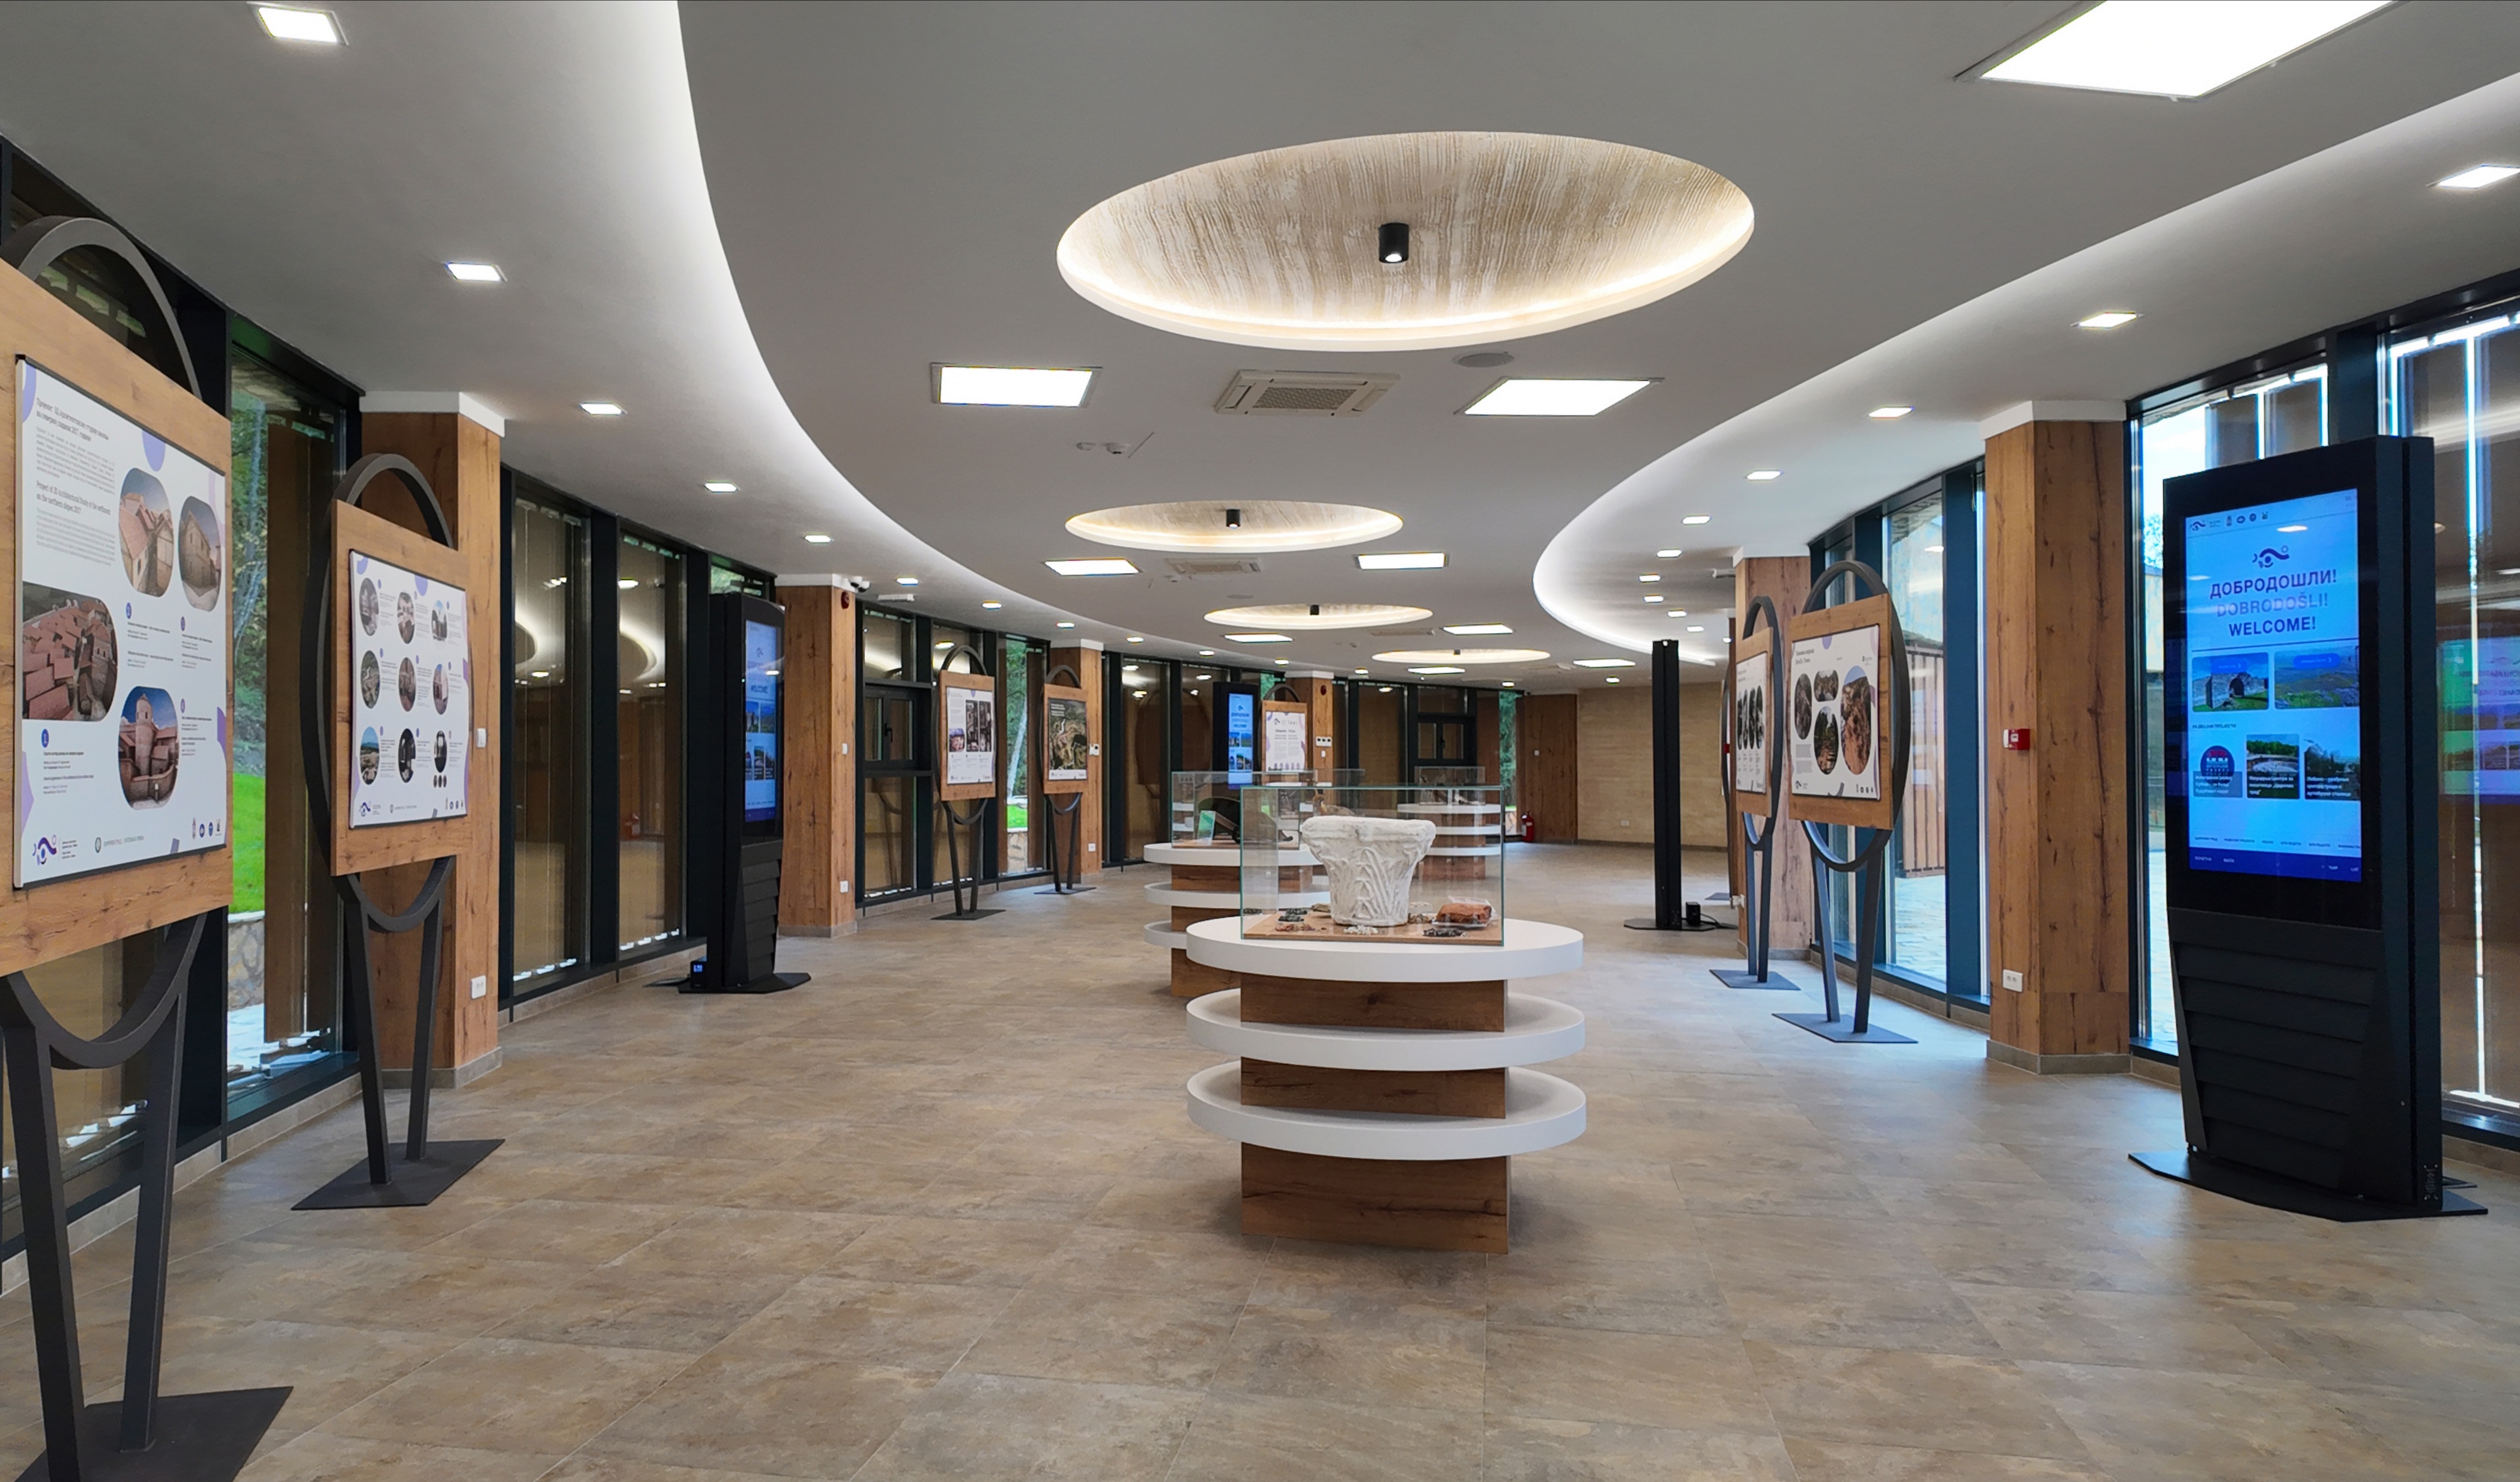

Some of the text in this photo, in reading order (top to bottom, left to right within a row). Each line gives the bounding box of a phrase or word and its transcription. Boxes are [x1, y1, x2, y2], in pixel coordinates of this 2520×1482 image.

[2210, 569, 2337, 599] ДОБРОДОШЛИ!
[2217, 592, 2328, 617] DOBRODOŠLI!
[2229, 616, 2316, 637] WELCOME!
